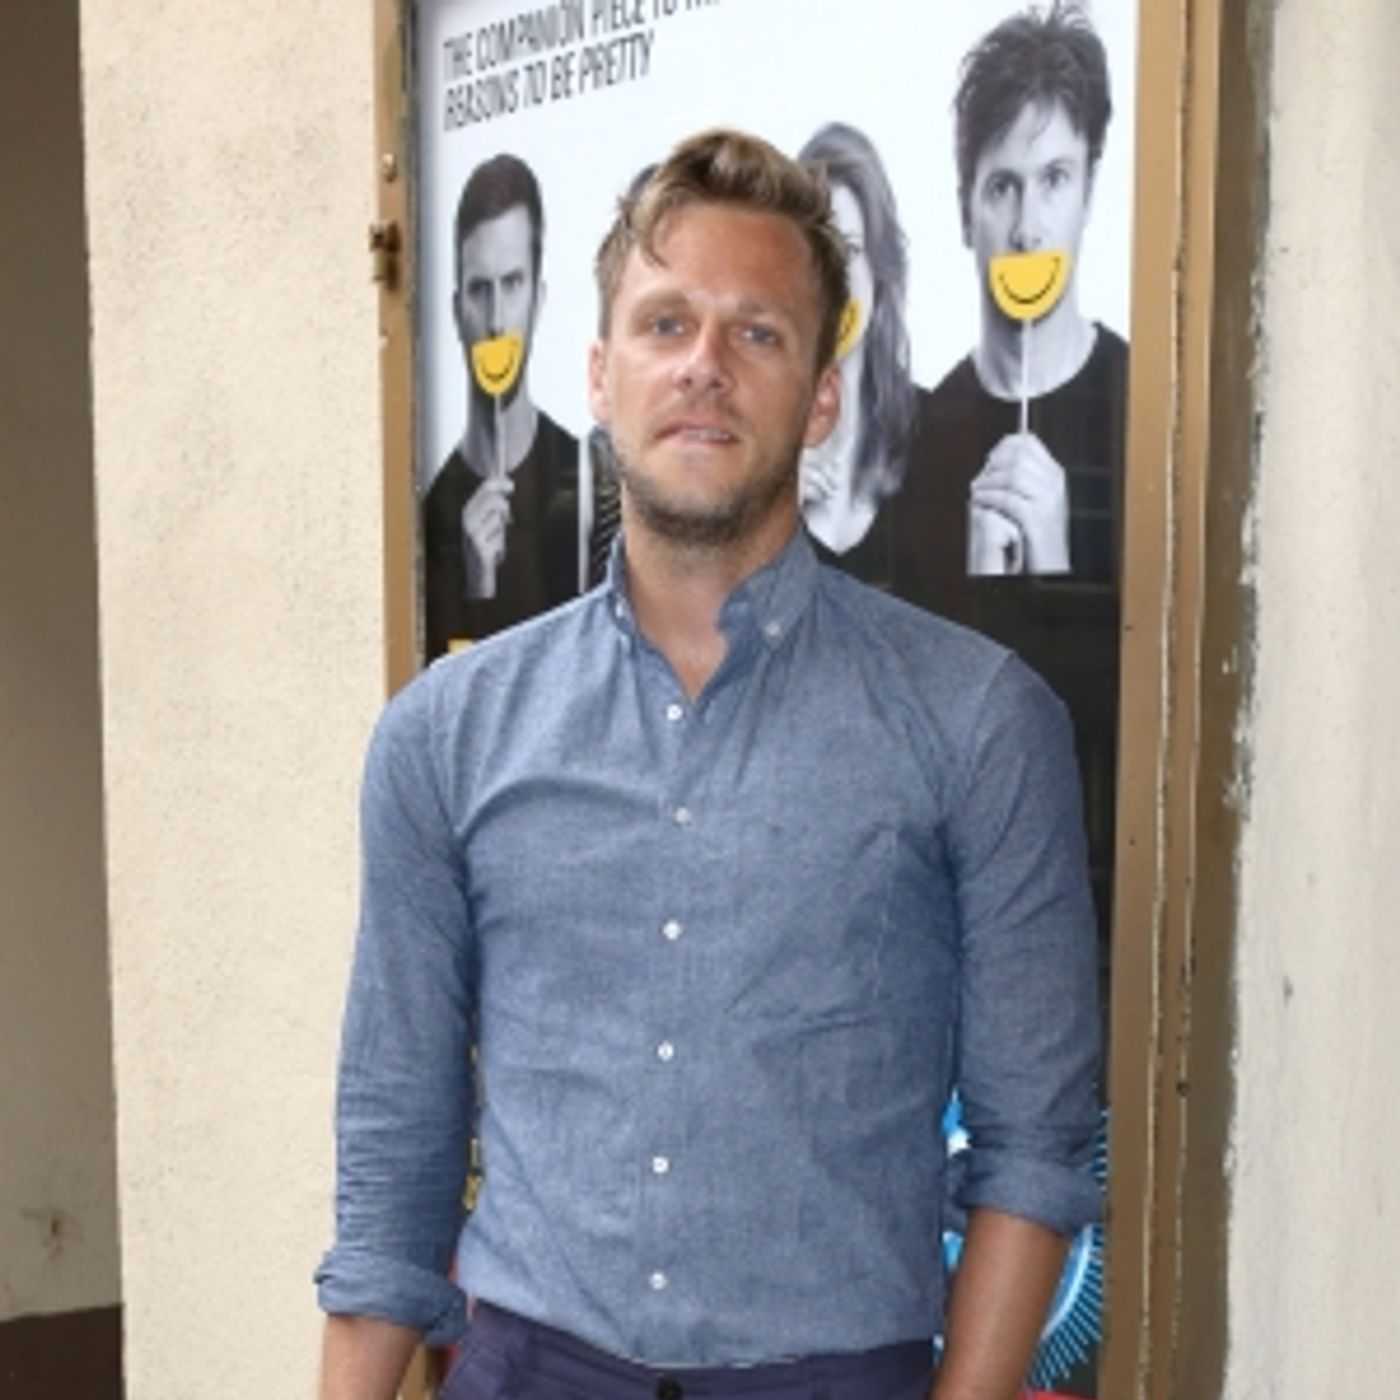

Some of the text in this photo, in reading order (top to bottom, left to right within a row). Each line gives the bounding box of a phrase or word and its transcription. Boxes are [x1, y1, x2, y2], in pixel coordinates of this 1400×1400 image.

[443, 32, 472, 81] THE
[476, 0, 585, 71] COMPANION
[444, 29, 655, 131] REASONS TO BE PRETTY
